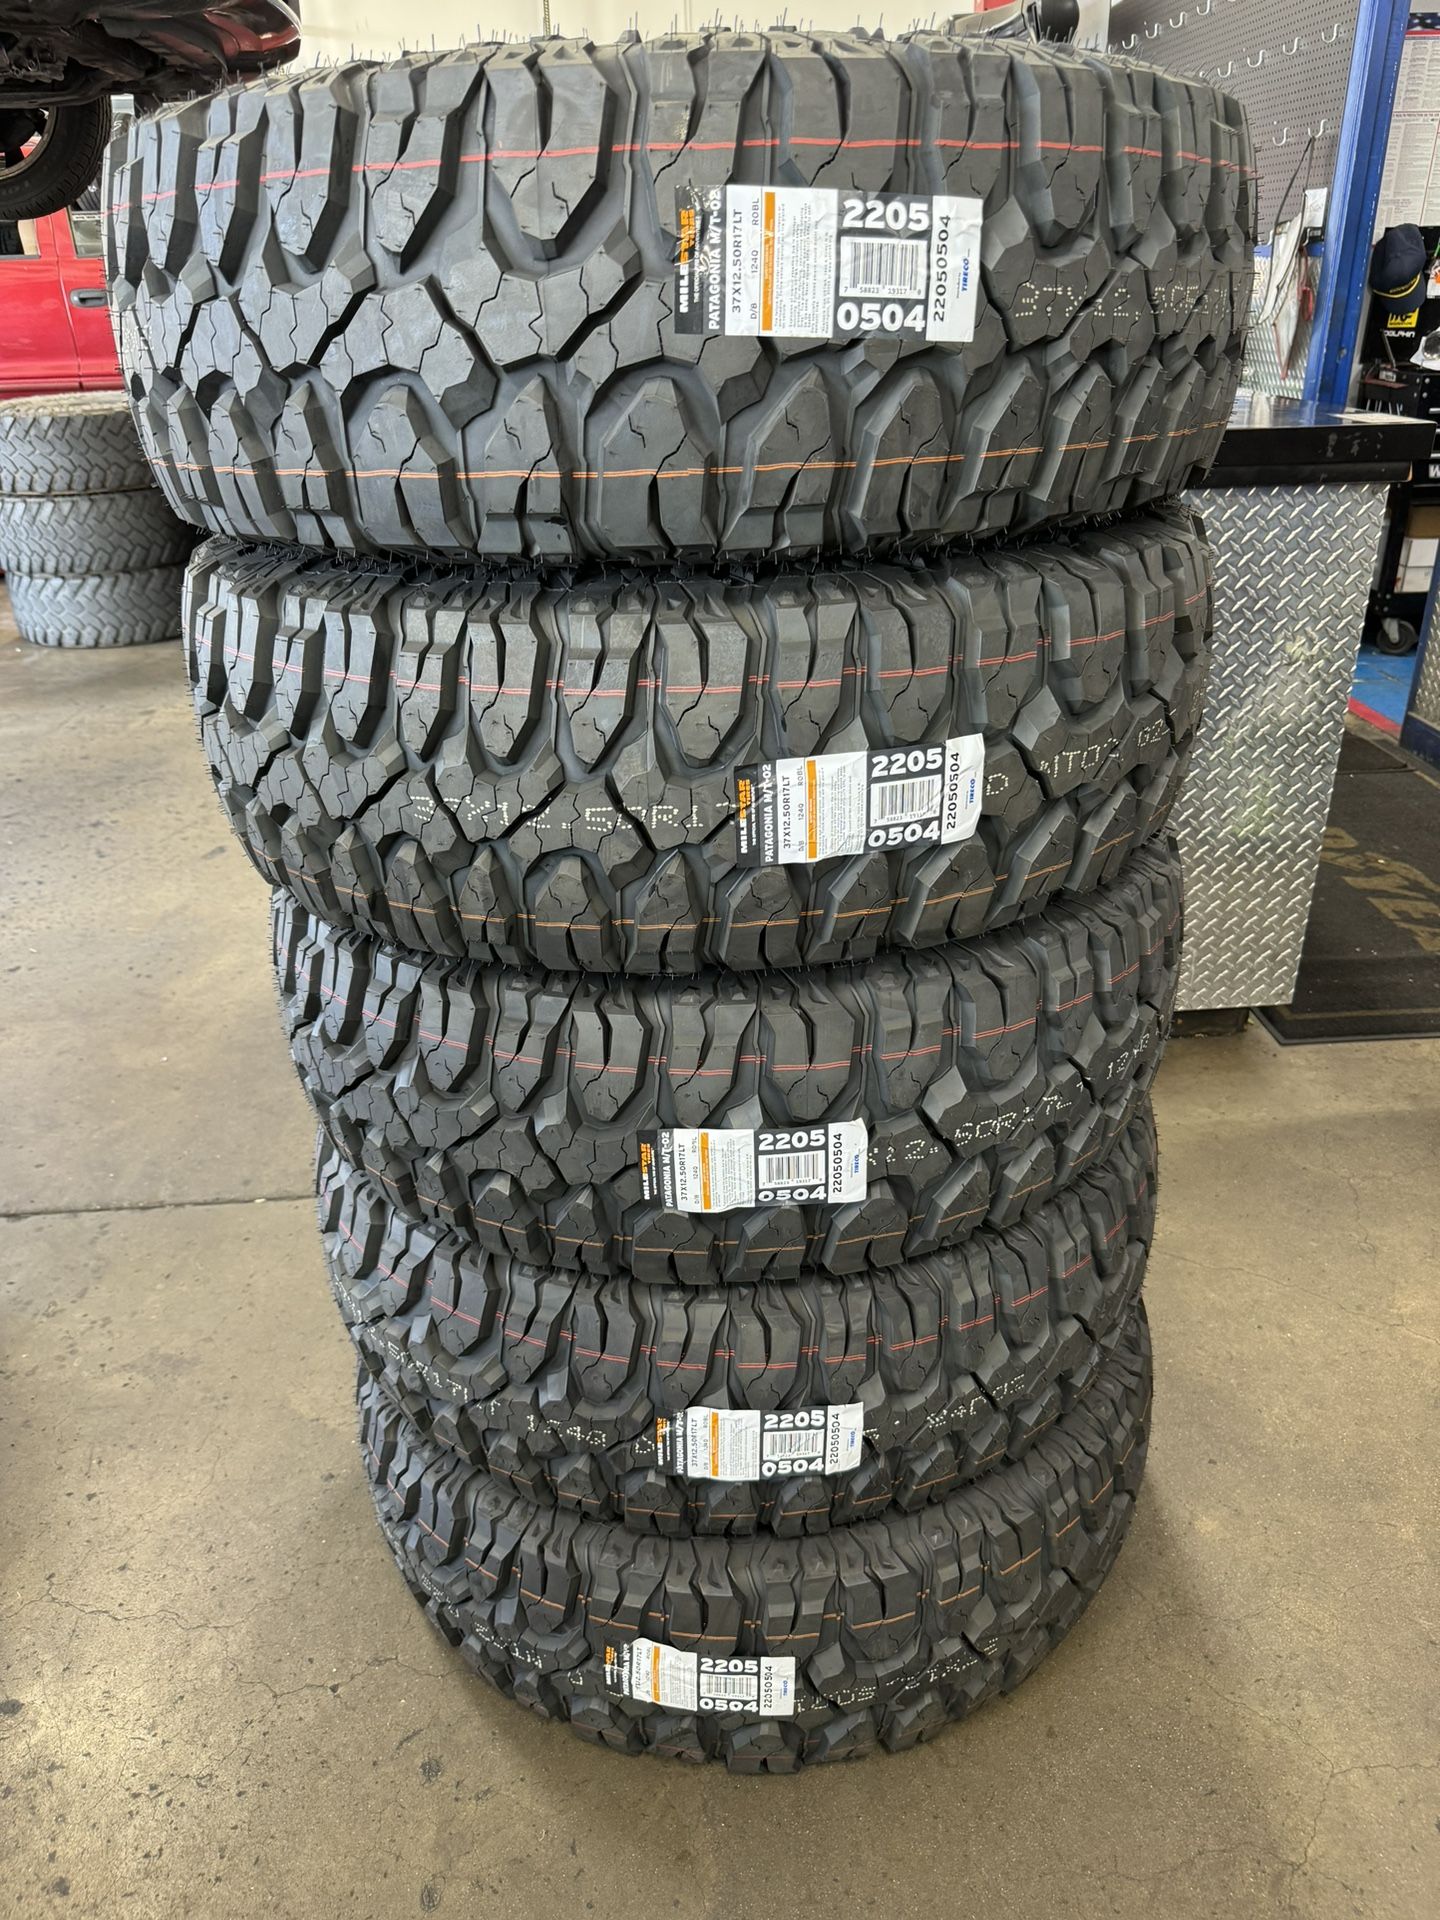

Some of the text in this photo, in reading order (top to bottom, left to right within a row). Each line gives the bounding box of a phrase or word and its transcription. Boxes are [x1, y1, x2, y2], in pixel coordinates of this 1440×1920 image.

[842, 198, 930, 231] 2205
[732, 209, 743, 313] 37X12.50R17LT
[933, 214, 951, 323] 22050504
[961, 258, 970, 292] TIRECO
[709, 248, 722, 330] PATAGONIA
[836, 302, 926, 332] 0504
[871, 747, 943, 778] 2205
[782, 775, 791, 849] 37X12.50R17LT
[946, 752, 960, 830] 22050504
[738, 779, 748, 854] MILESTAR
[764, 805, 774, 863] PATAGONIA
[868, 820, 941, 848] 0504
[758, 1129, 826, 1151] 2205
[679, 1143, 688, 1201] 37X12.50R17LT
[832, 1132, 842, 1193] 22050504
[663, 1165, 674, 1207] PATAGONIA
[758, 1185, 827, 1202] 0504
[764, 1410, 825, 1430] 2205
[830, 1413, 840, 1465] 22050504
[761, 1458, 825, 1477] 0504
[700, 1658, 759, 1673] 2205
[699, 1698, 759, 1713] 0504
[763, 1665, 773, 1709] 22050504
